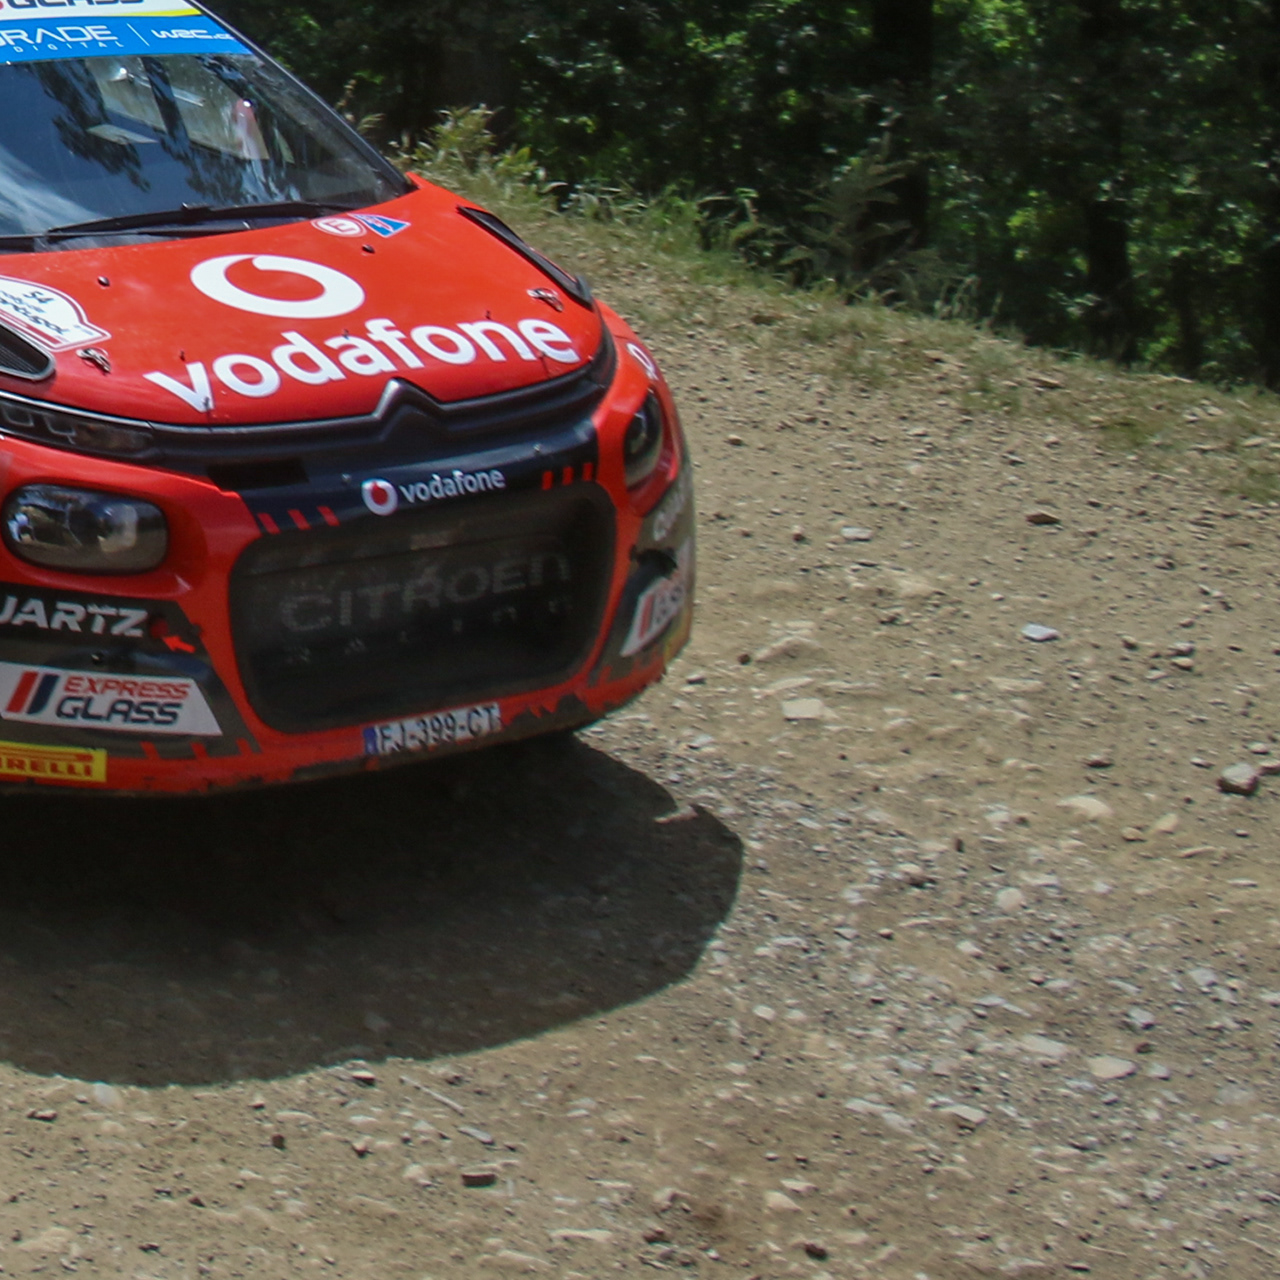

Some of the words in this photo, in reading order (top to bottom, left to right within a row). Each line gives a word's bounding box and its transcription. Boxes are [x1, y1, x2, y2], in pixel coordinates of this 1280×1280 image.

[13, 38, 125, 54] DIGITAL
[142, 318, 581, 414] vodafone
[399, 467, 507, 506] vodafone
[63, 675, 192, 701] EXPRESS
[56, 696, 182, 726] GLASS
